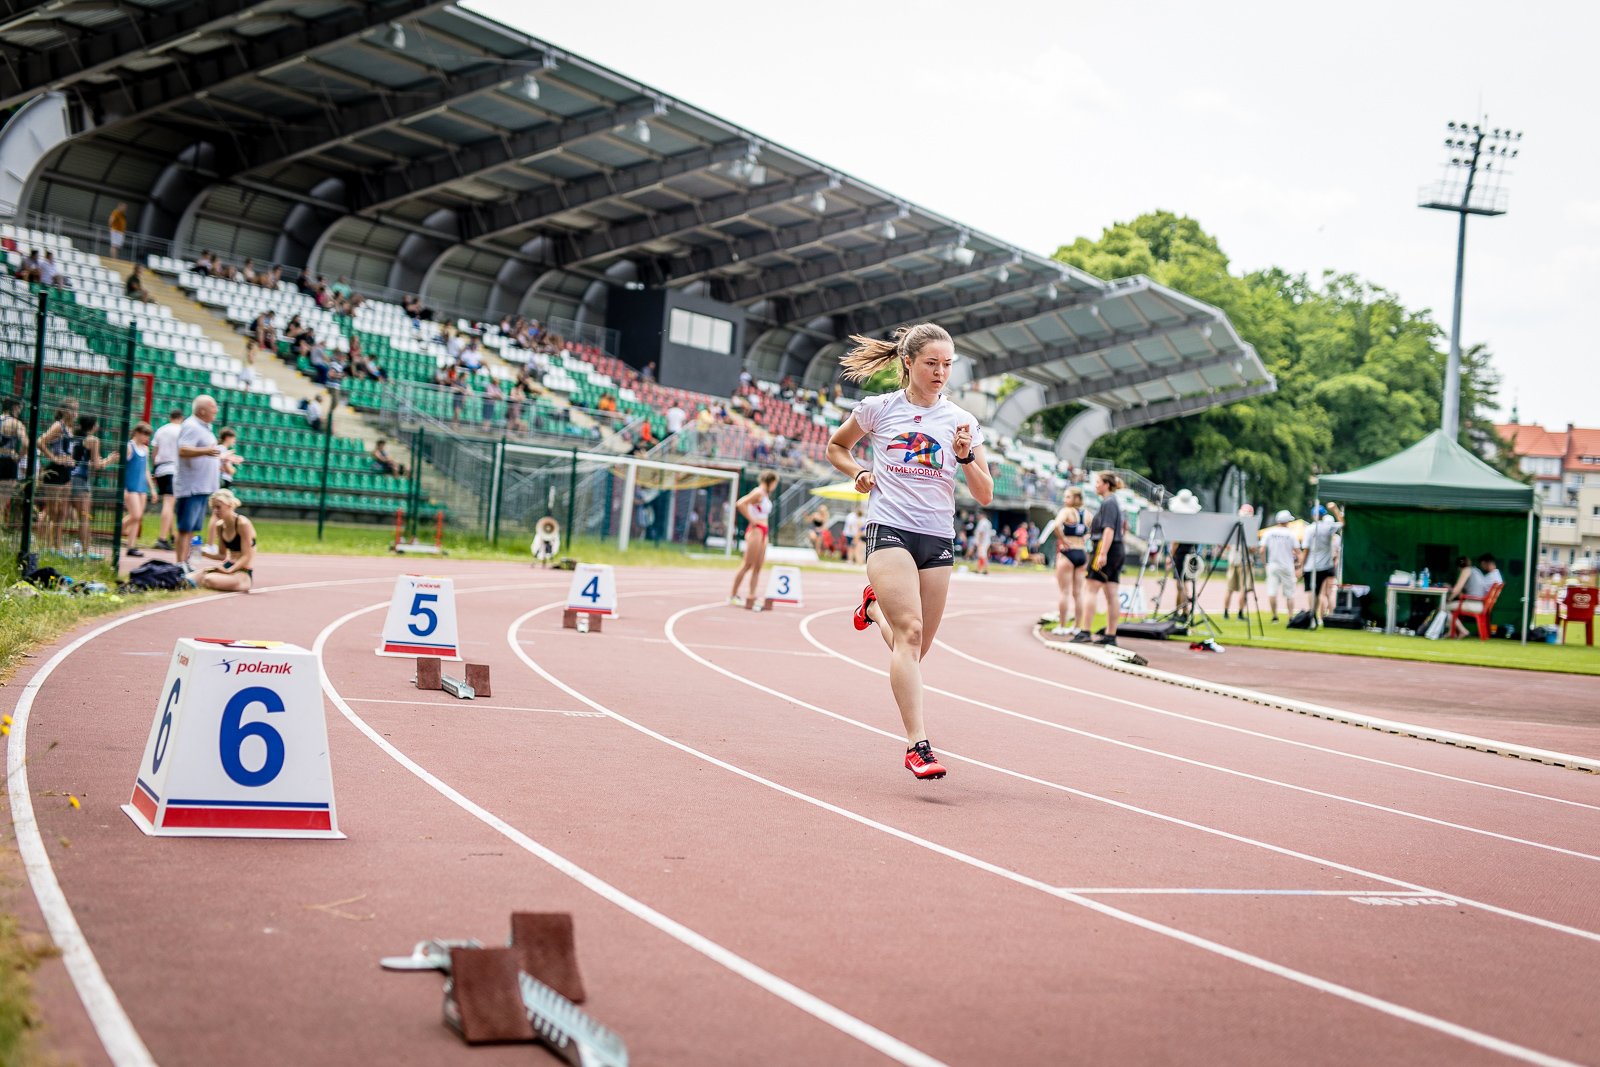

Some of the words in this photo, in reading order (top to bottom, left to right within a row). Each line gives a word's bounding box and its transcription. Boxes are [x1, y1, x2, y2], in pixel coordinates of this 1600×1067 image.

[581, 576, 600, 603] 4
[777, 575, 790, 595] 3
[1119, 592, 1130, 610] 2
[408, 593, 438, 637] 5
[235, 660, 293, 675] polanik
[152, 677, 181, 775] 6
[219, 686, 286, 787] 6
